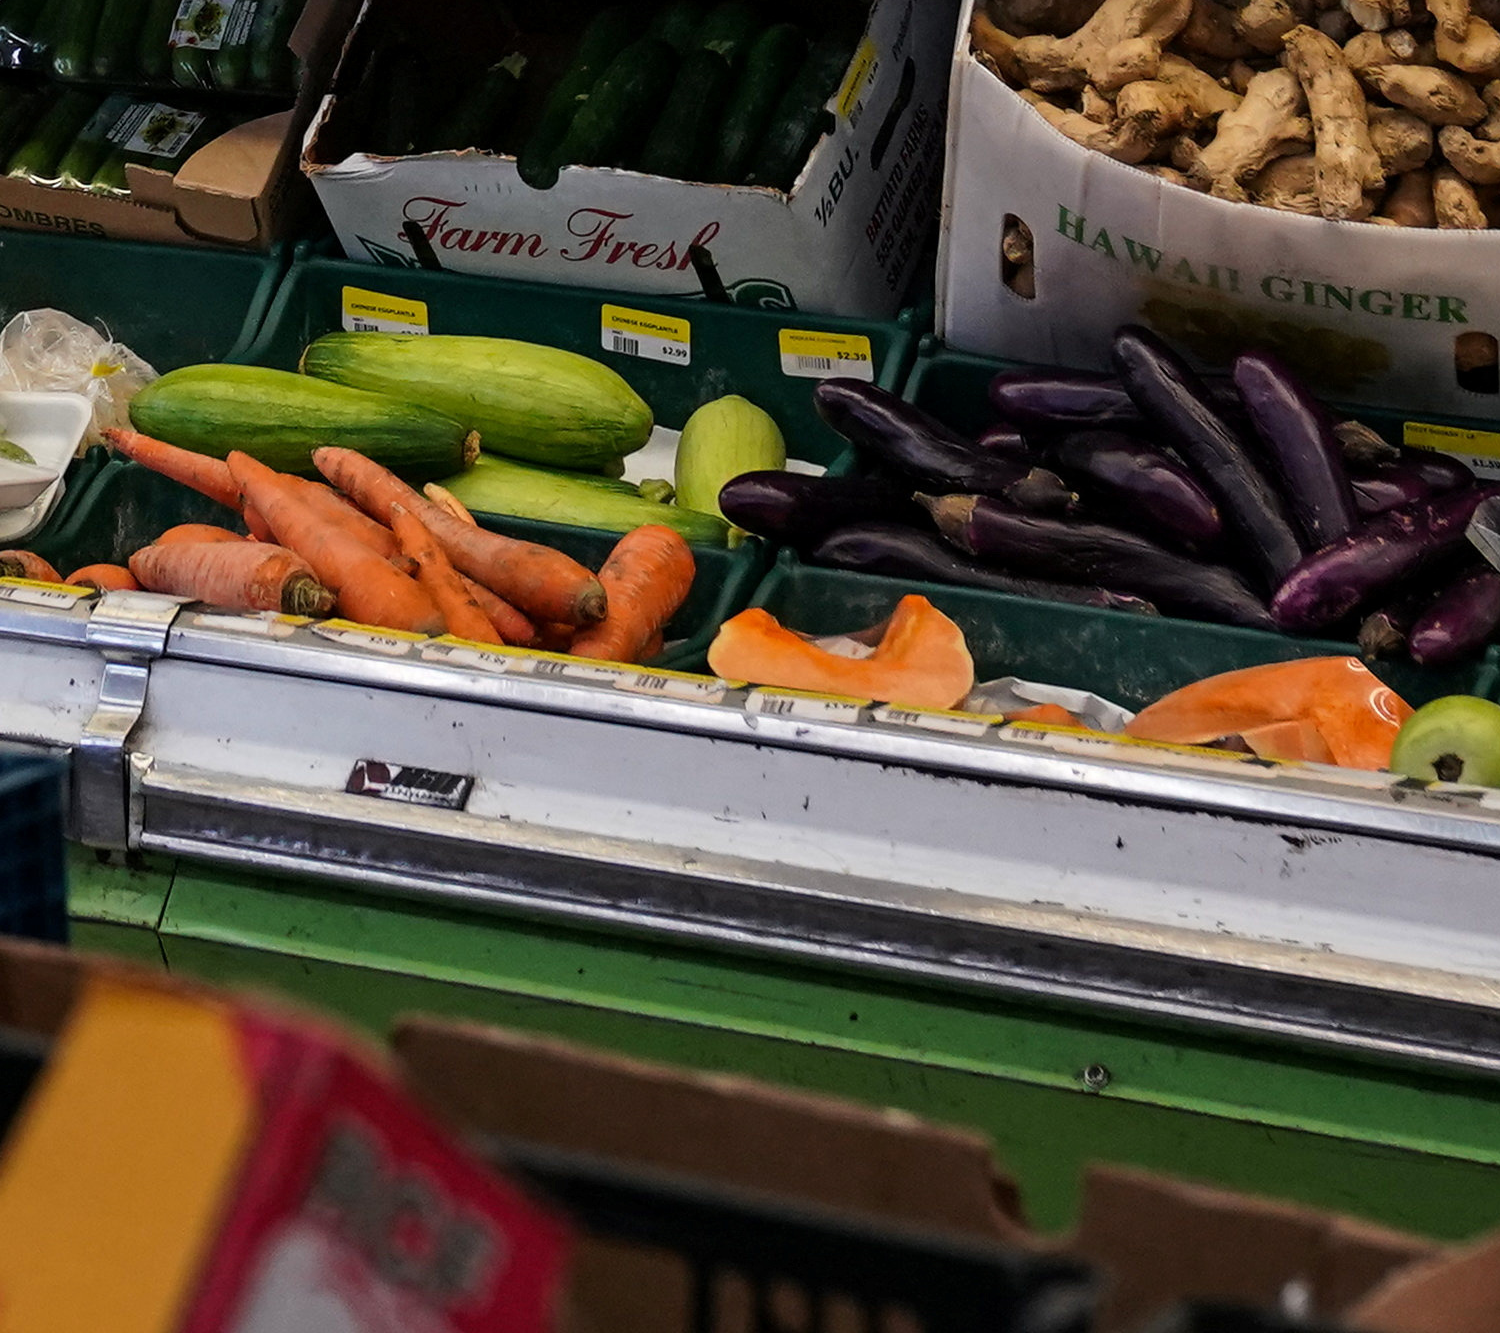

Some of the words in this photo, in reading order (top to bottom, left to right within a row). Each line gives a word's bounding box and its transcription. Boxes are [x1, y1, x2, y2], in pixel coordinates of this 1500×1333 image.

[865, 157, 903, 246] BATTIATO
[899, 102, 929, 163] FARMS
[398, 196, 548, 259] Farm
[559, 207, 721, 271] Fresh
[1053, 201, 1240, 299] HAWAII
[1261, 271, 1471, 328] GINGER
[661, 346, 688, 360] $2.99
